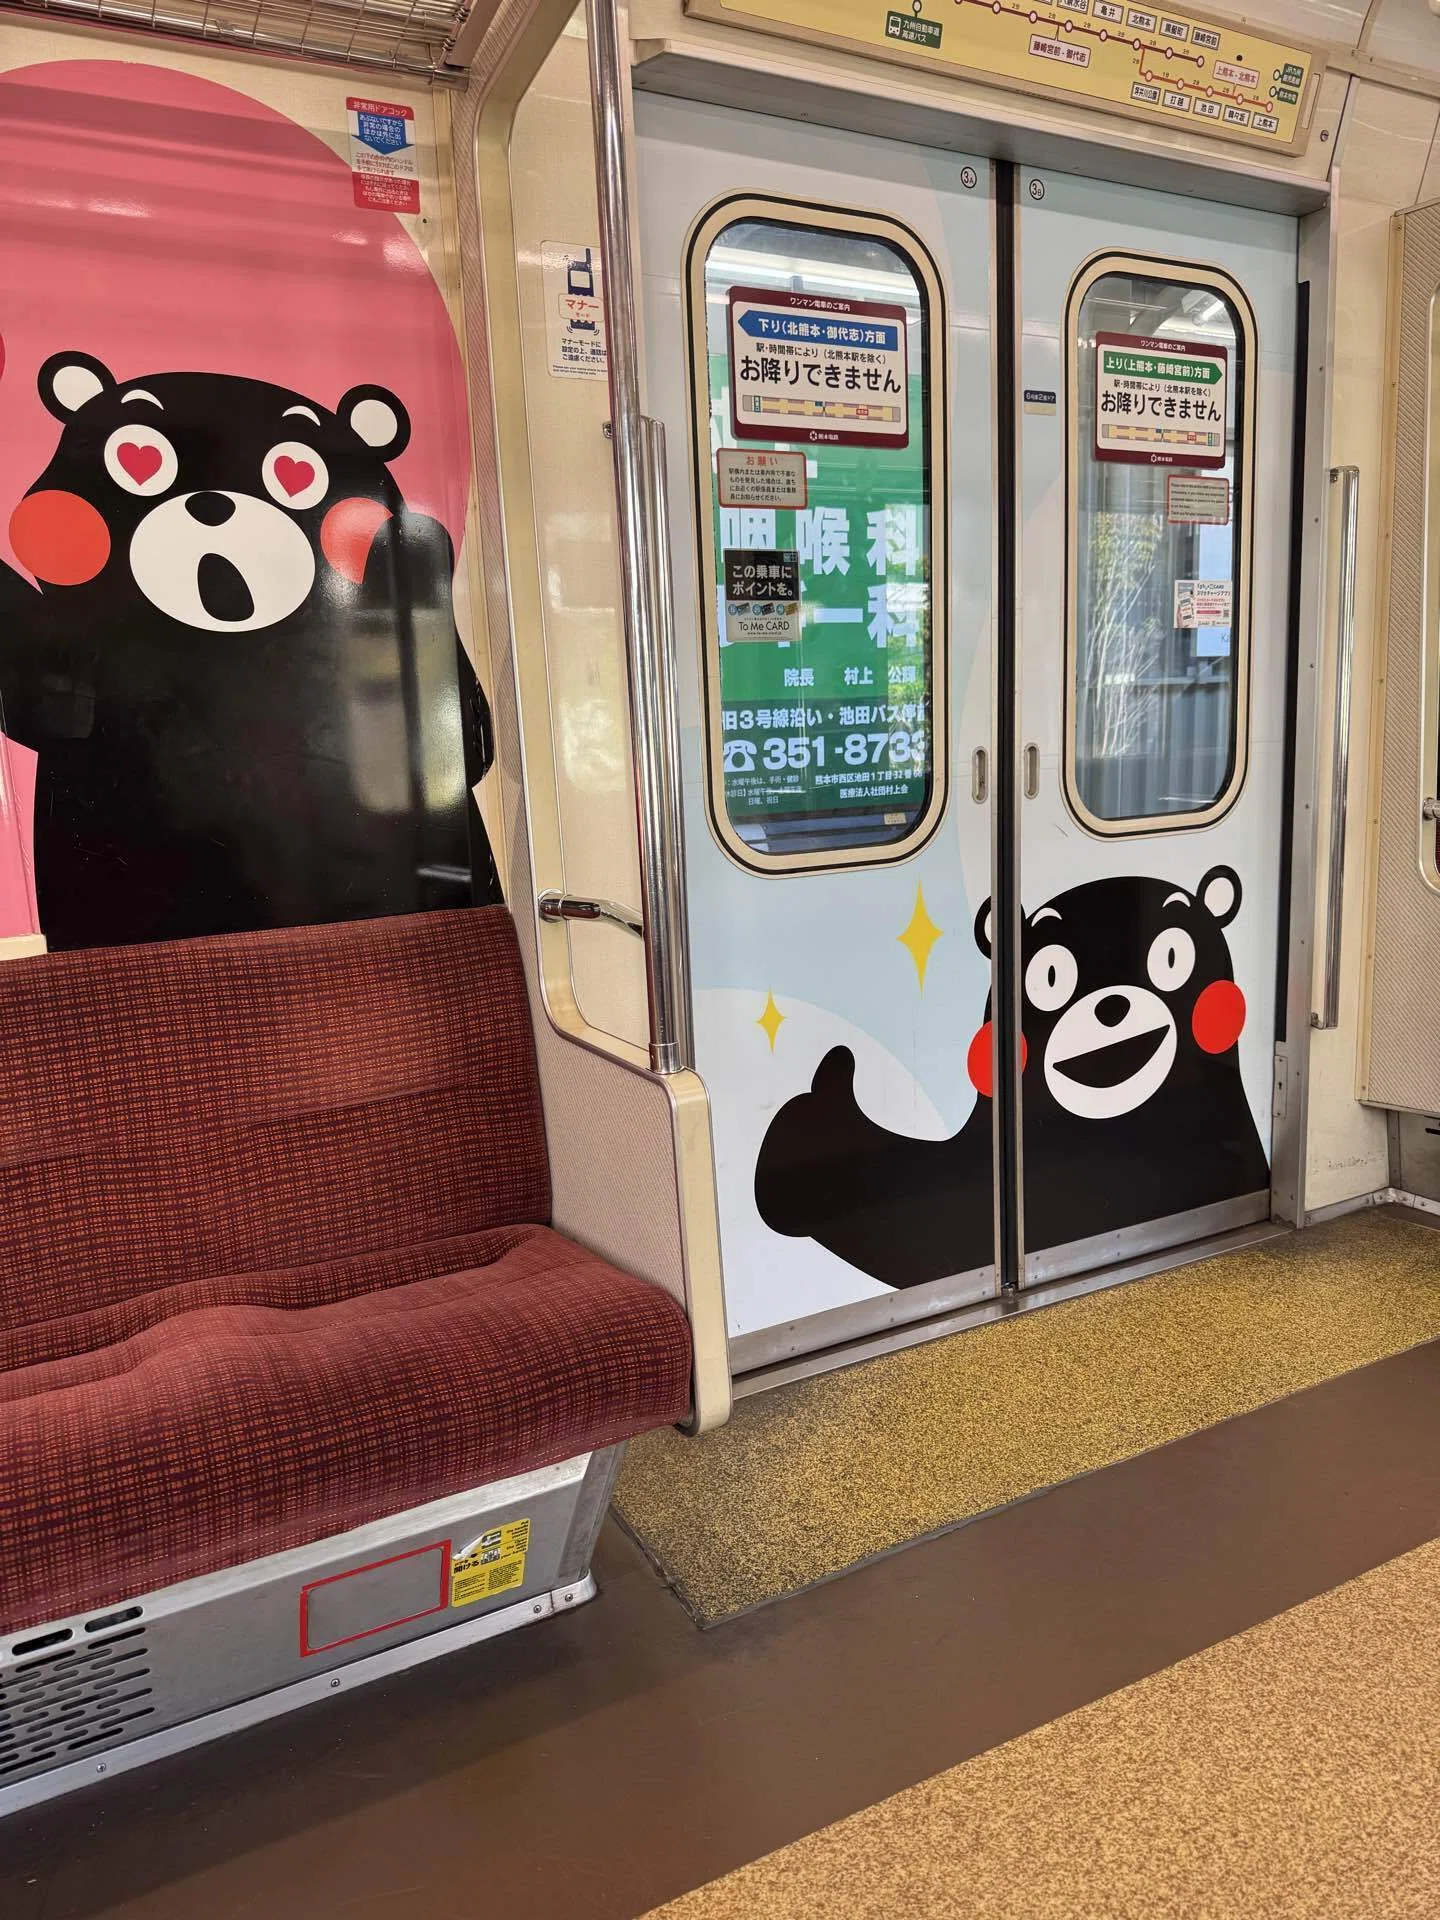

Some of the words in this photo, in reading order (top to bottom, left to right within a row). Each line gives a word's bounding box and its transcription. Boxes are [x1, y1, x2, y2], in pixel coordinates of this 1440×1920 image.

[1131, 15, 1152, 28] 北熊本
[353, 101, 407, 117] 非常用ドアコック
[1200, 103, 1215, 115] 池田
[565, 299, 599, 310] マナー
[790, 297, 851, 312] ワンマン電車のご案内
[758, 318, 886, 345] 下り（北熊本・御代志）方面
[561, 338, 601, 348] マナーモードに
[1140, 340, 1186, 352] ワンマン電車のご案内
[740, 356, 902, 394] お降りできません
[1101, 390, 1222, 422] お降りできません
[746, 456, 778, 466] お願い
[732, 565, 792, 579] この乗車に
[732, 581, 793, 597] ポイントを。
[738, 621, 749, 631] To
[750, 621, 764, 631] Me
[765, 621, 790, 631] CARD
[784, 668, 815, 687] 院長
[844, 667, 873, 685] 村上
[839, 784, 909, 799] 医療法人社団村上会
